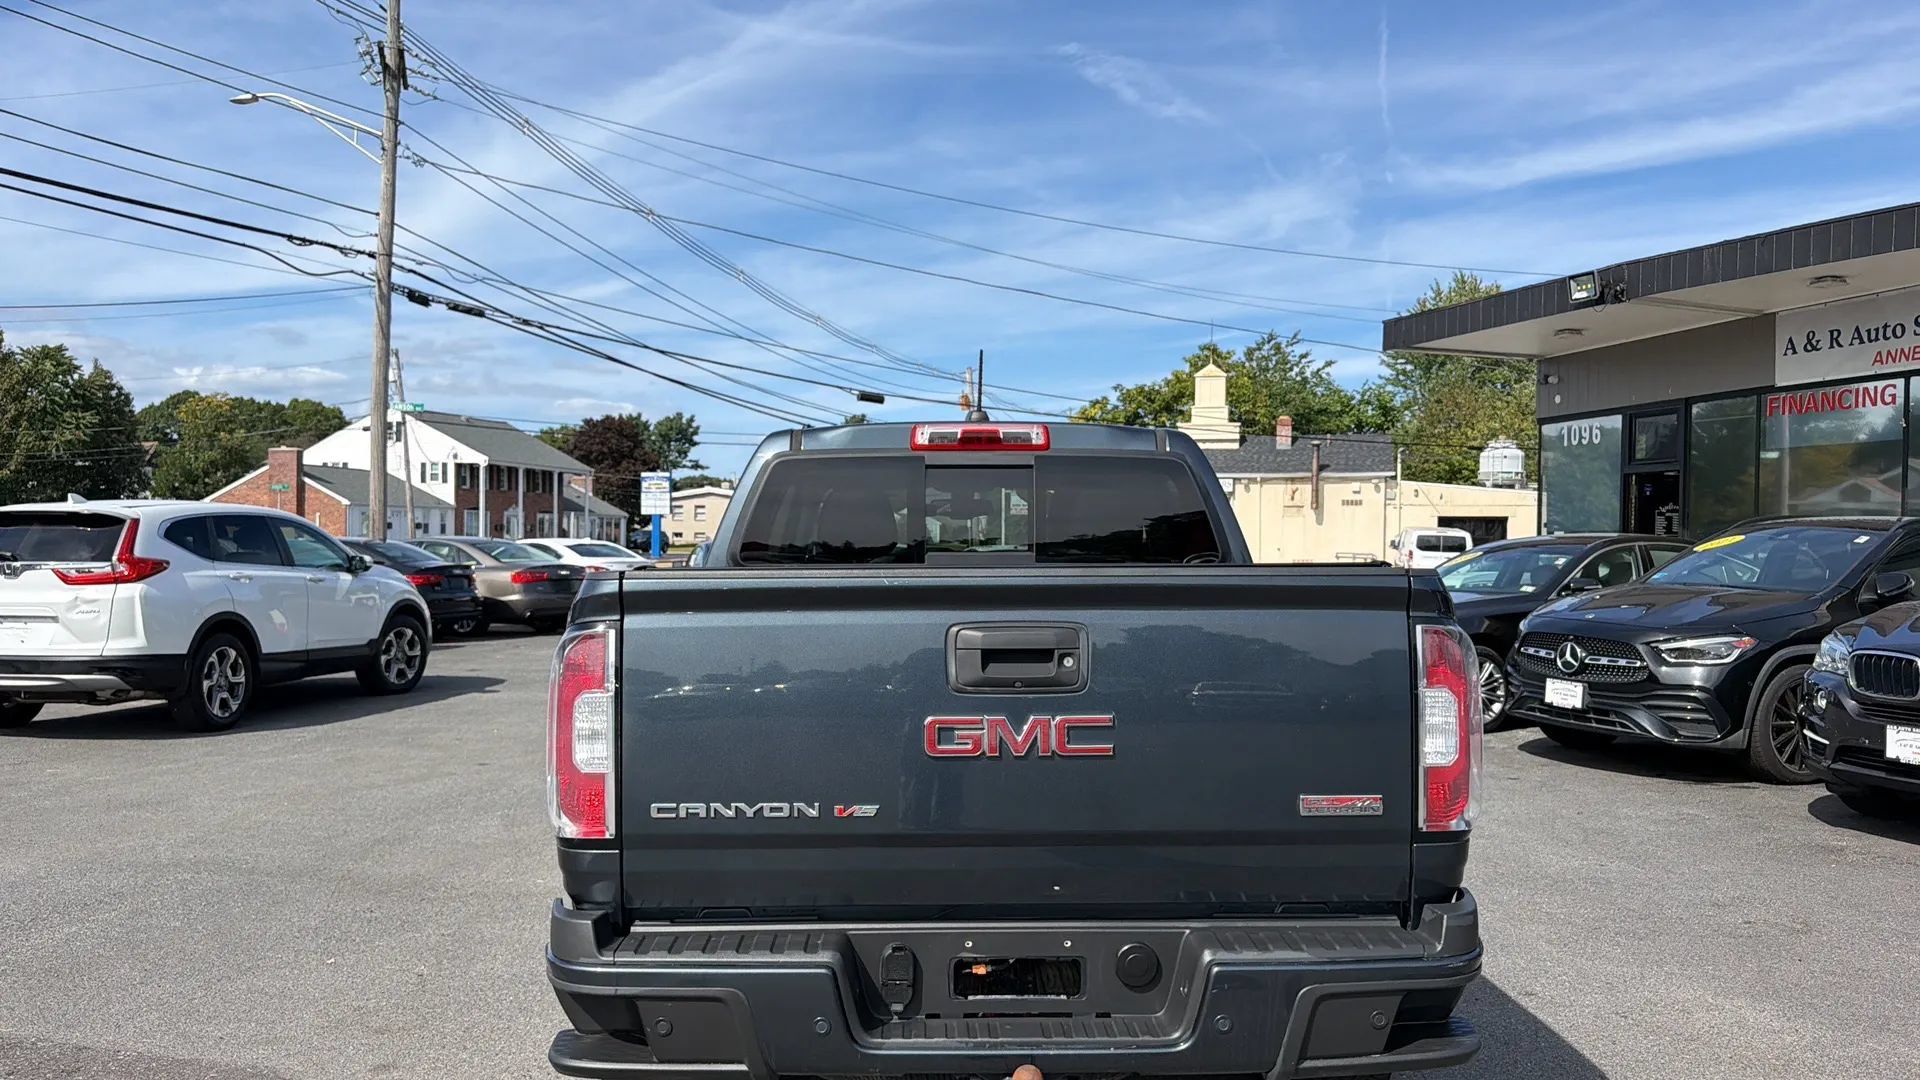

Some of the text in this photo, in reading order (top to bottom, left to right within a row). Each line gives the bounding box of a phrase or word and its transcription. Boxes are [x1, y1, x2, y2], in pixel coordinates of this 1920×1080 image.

[1783, 336, 1798, 356] A
[1803, 330, 1822, 353] &
[1828, 328, 1844, 350] R
[1848, 321, 1906, 347] Auto
[1766, 383, 1897, 417] FINANCING
[1561, 422, 1601, 447] 1096
[924, 714, 1115, 757] GMC
[650, 802, 880, 819] CANYON V6
